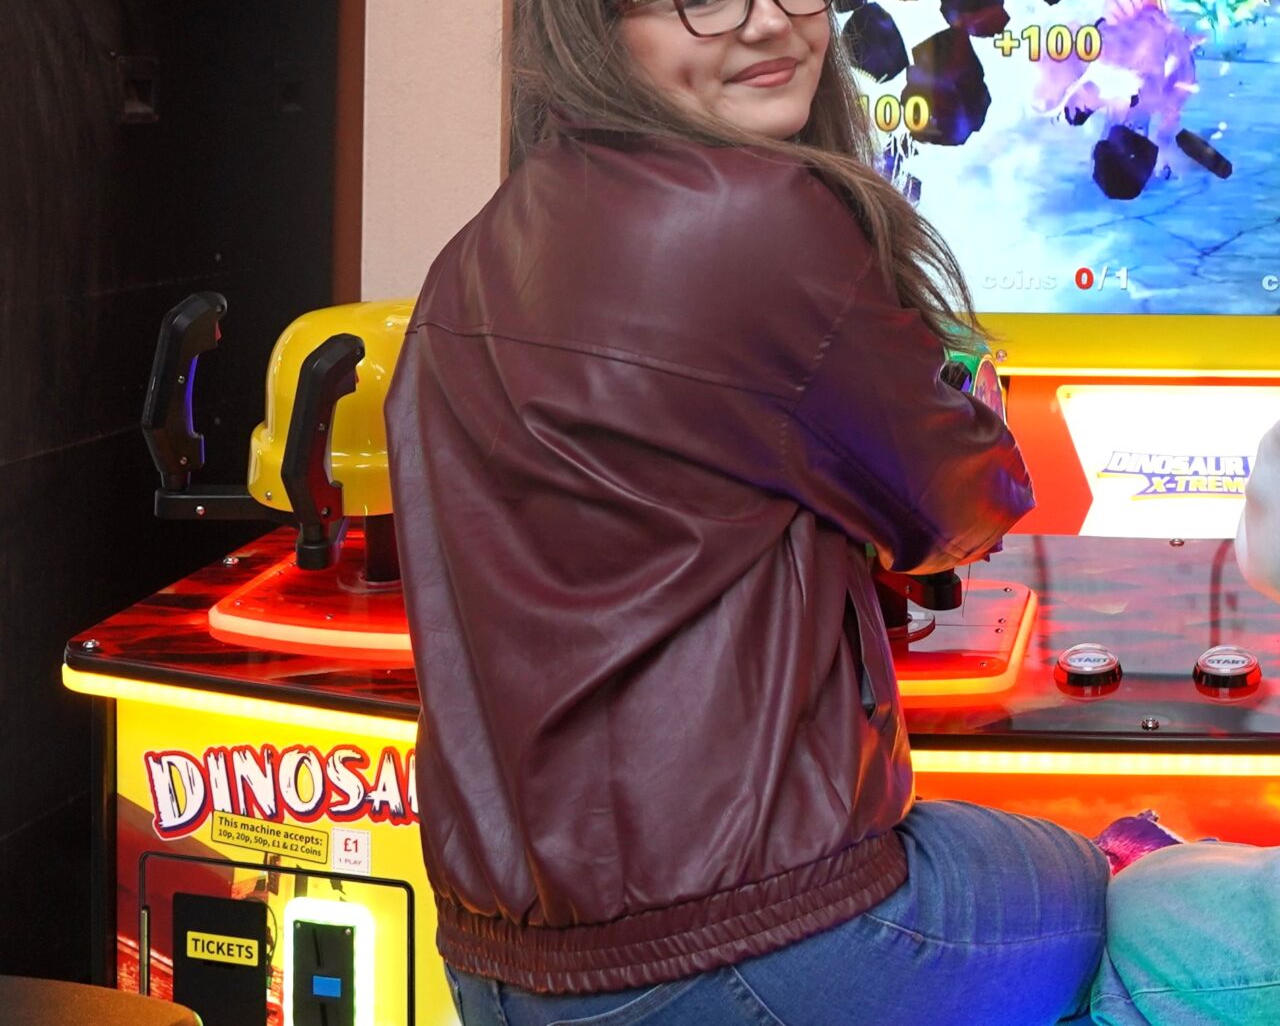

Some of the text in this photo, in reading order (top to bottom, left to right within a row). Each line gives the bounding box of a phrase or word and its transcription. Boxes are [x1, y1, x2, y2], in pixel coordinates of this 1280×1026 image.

[994, 24, 1103, 62] +100
[981, 269, 1058, 290] coins
[1106, 451, 1246, 476] DINOSAUR
[1150, 476, 1247, 493] X-TREM
[218, 816, 323, 846] This machine accepts:
[272, 840, 281, 848] £1
[290, 843, 299, 852] £2
[300, 846, 322, 857] Coins
[343, 837, 359, 853] £1
[344, 858, 363, 866] PLAY
[192, 937, 254, 960] TICKETS
